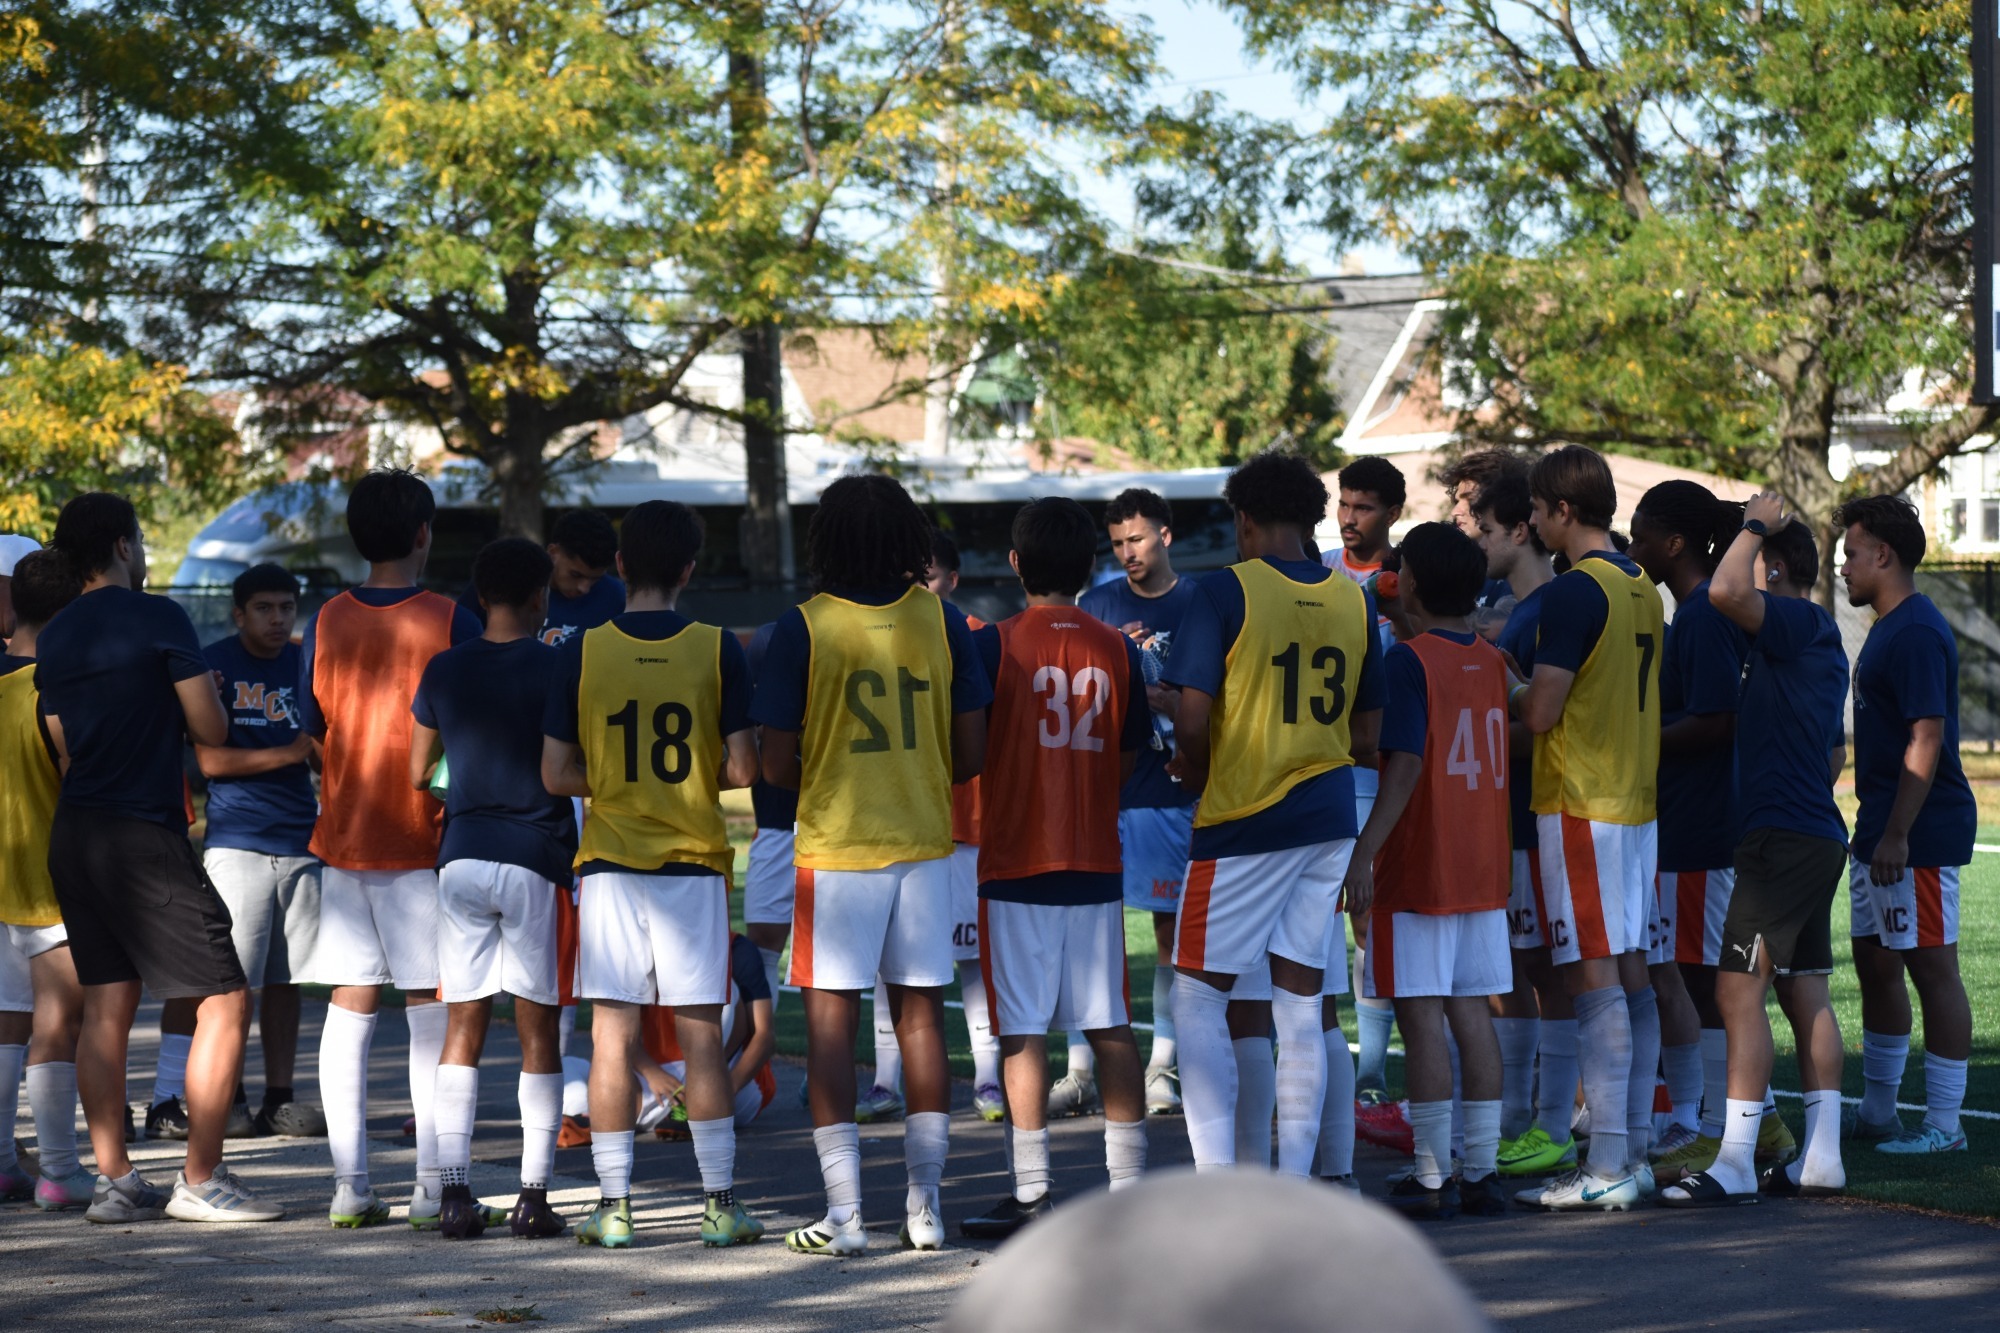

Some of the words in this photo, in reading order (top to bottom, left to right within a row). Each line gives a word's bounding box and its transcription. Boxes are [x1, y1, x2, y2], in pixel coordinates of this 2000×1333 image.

[233, 681, 288, 721] MC
[1033, 665, 1110, 753] 32
[1271, 641, 1346, 726] 13
[1635, 632, 1655, 713] 7
[607, 699, 693, 784] 18
[1446, 707, 1505, 791] 40
[1152, 878, 1182, 899] MC
